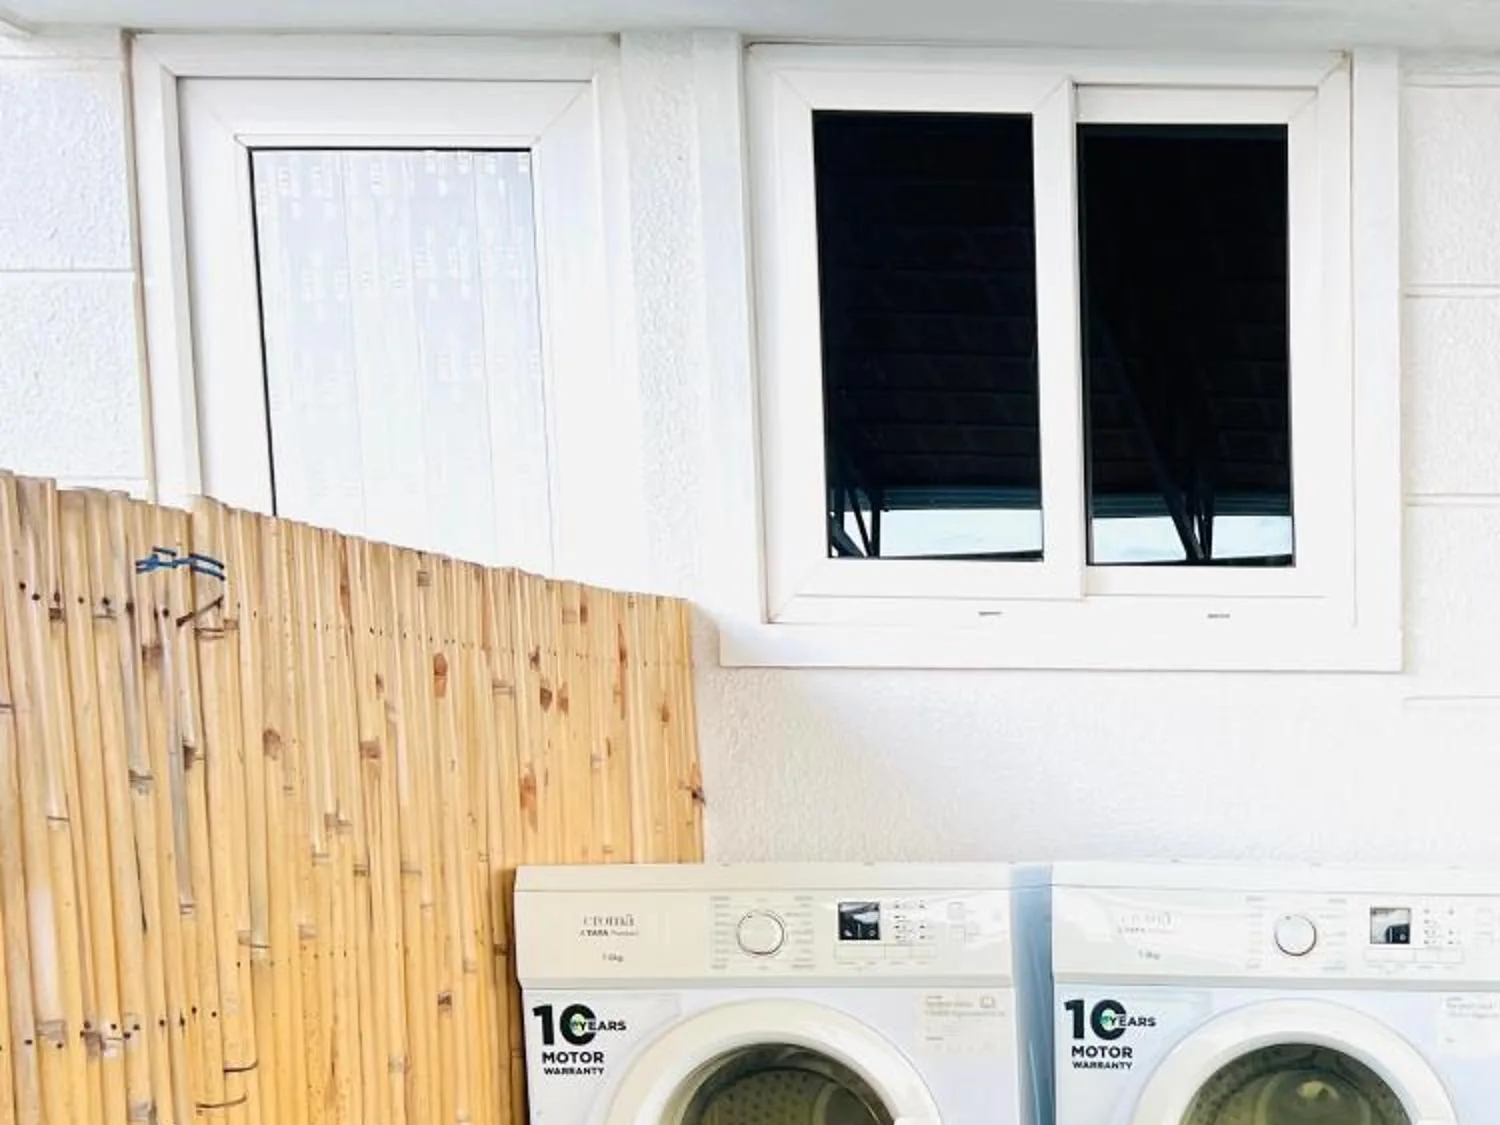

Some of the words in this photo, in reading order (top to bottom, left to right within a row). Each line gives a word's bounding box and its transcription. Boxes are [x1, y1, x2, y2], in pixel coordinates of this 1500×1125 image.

[532, 1003, 597, 1046] 10
[579, 1020, 627, 1031] YEARS
[1064, 999, 1127, 1040] 10
[1109, 1016, 1156, 1027] YEARS
[542, 1051, 604, 1064] MOTOR
[1071, 1045, 1133, 1059] MOTOR
[543, 1067, 604, 1075] WARRANTY
[1072, 1061, 1133, 1069] WARRANTY
